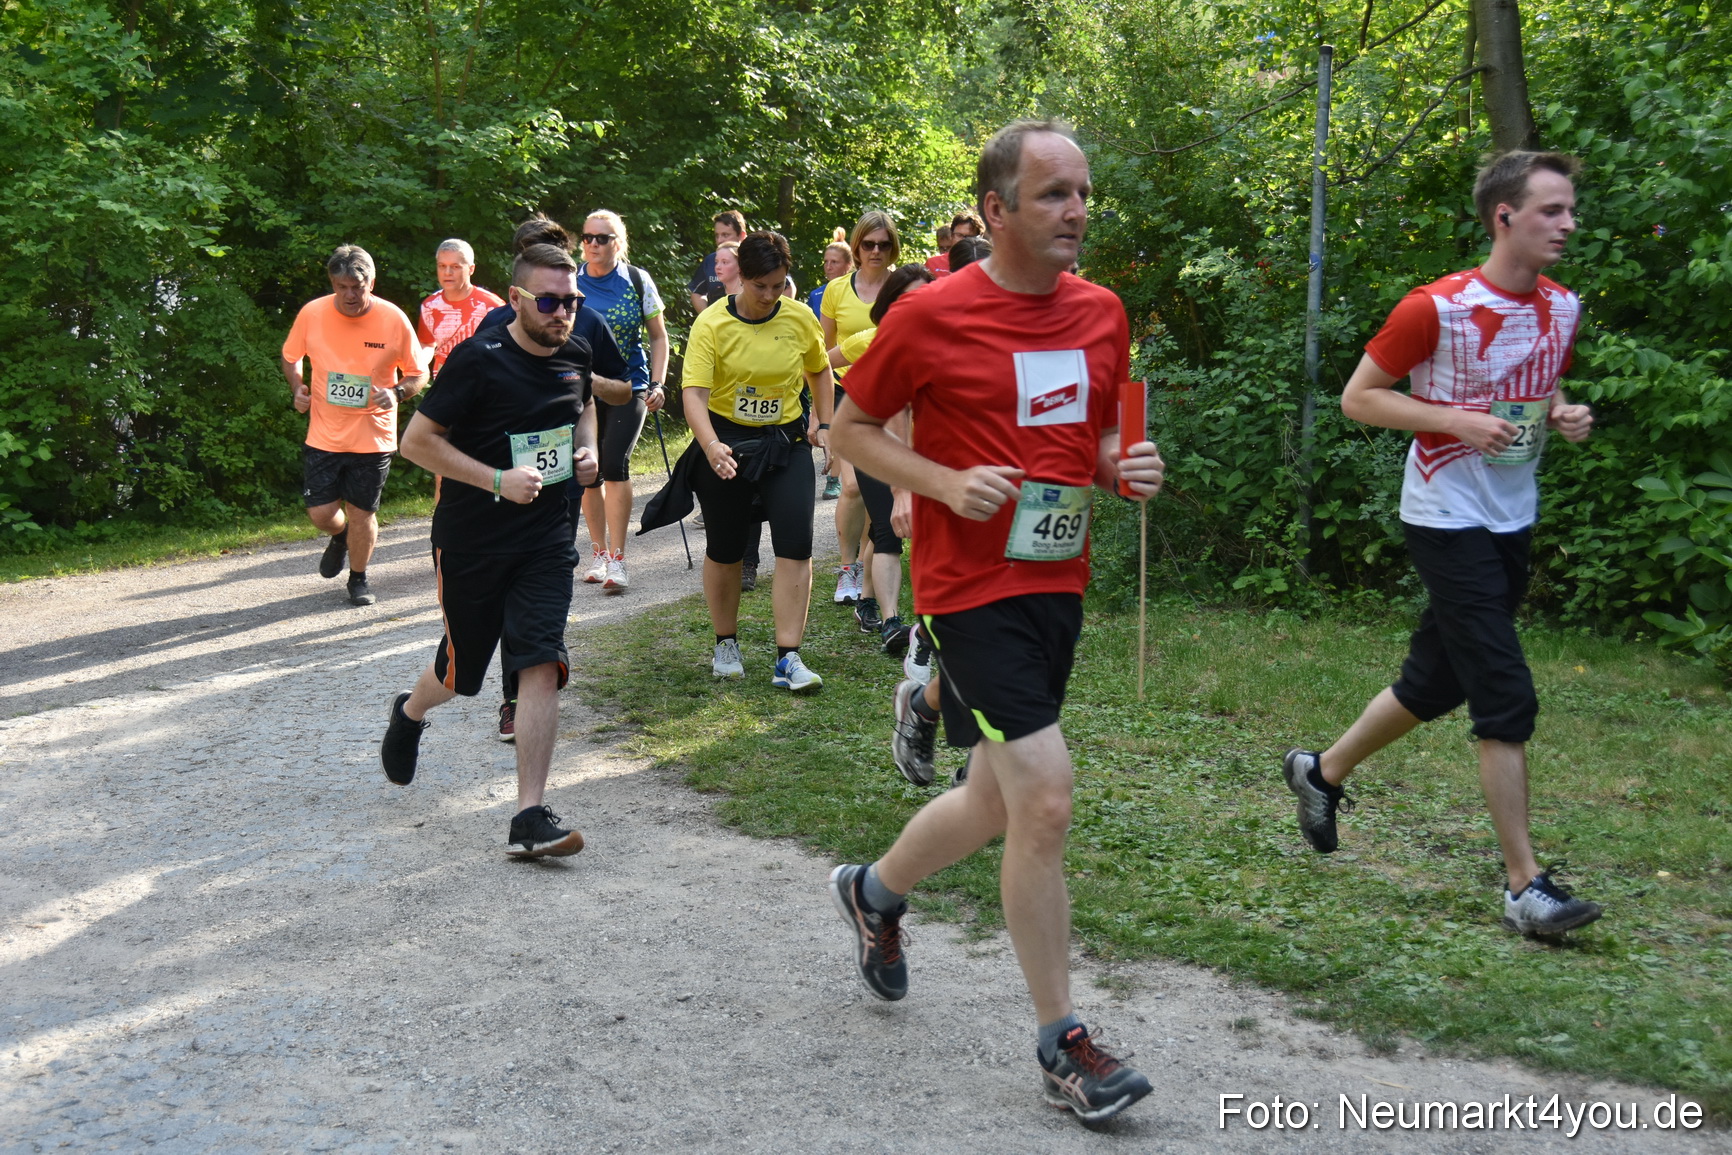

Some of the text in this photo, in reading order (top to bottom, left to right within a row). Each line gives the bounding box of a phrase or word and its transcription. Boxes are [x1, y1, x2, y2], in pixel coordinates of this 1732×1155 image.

[364, 341, 386, 349] THULE
[330, 383, 364, 399] 2304
[738, 397, 779, 414] 2185
[1043, 393, 1066, 408] DEHN
[536, 449, 559, 471] 53
[1033, 513, 1082, 540] 469
